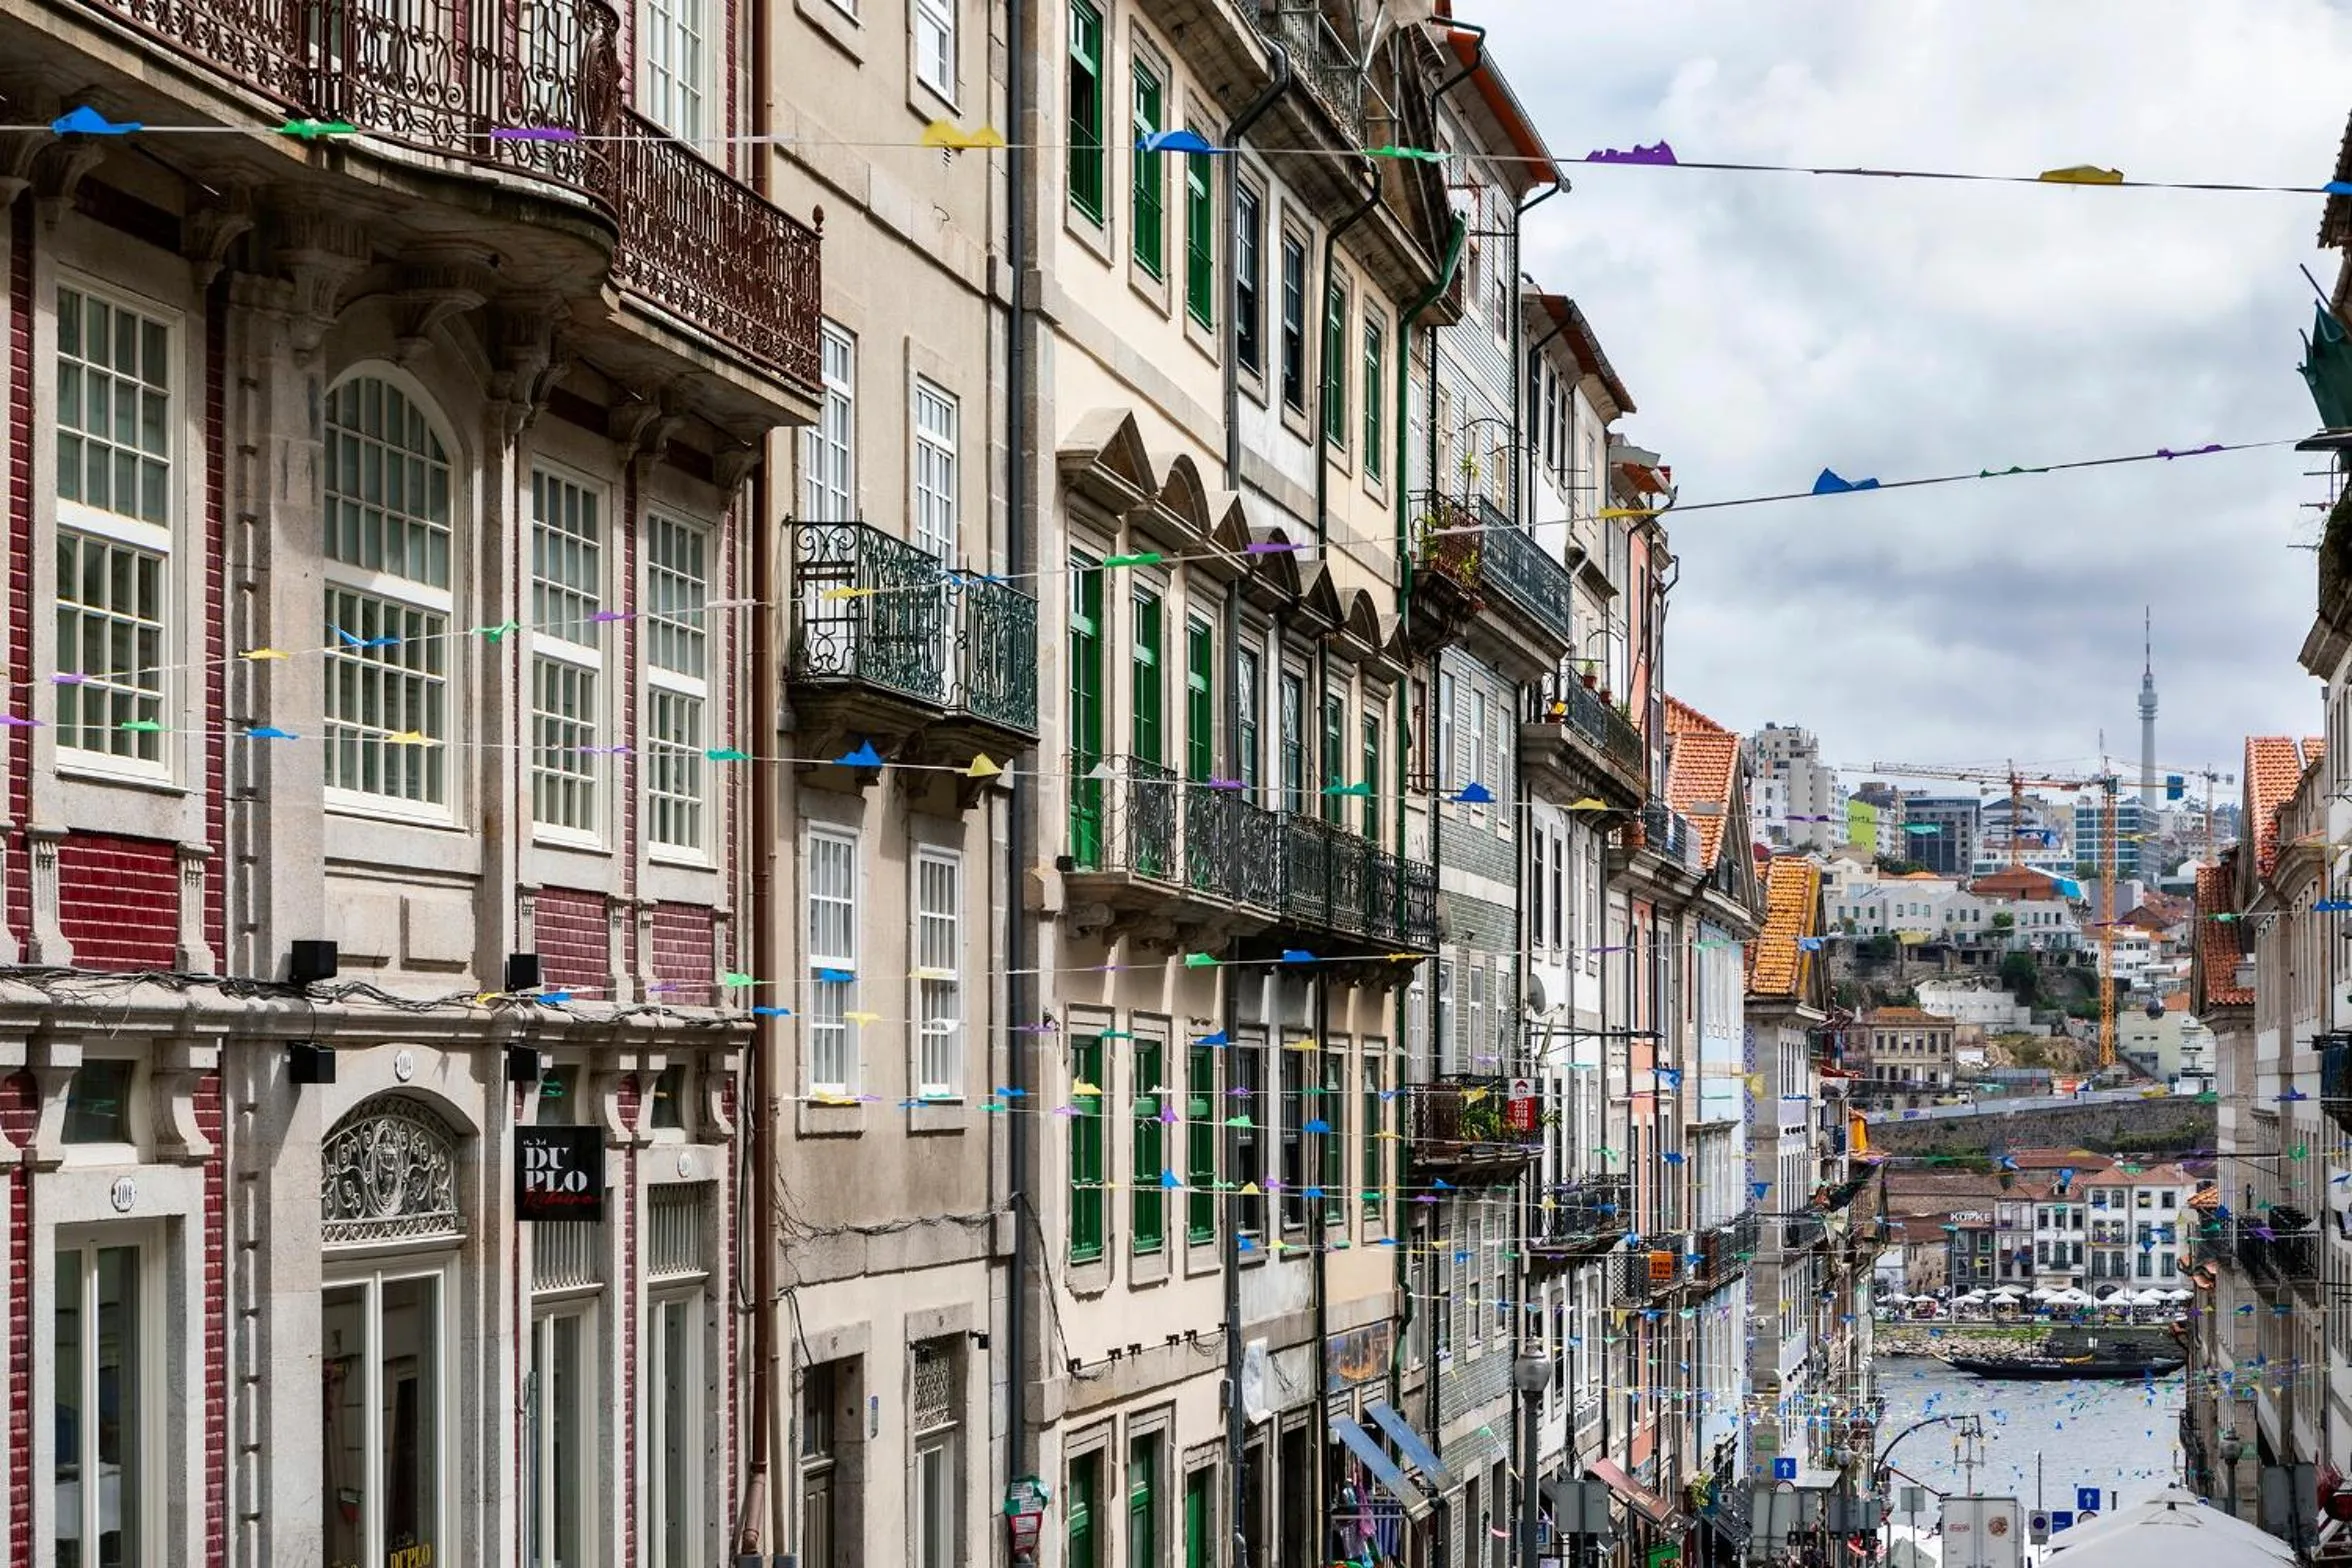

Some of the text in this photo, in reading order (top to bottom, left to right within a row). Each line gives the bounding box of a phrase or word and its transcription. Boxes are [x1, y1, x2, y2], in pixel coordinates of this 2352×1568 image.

[1514, 1100, 1528, 1109] 222
[524, 1147, 570, 1169] DU
[524, 1170, 588, 1193] PLO
